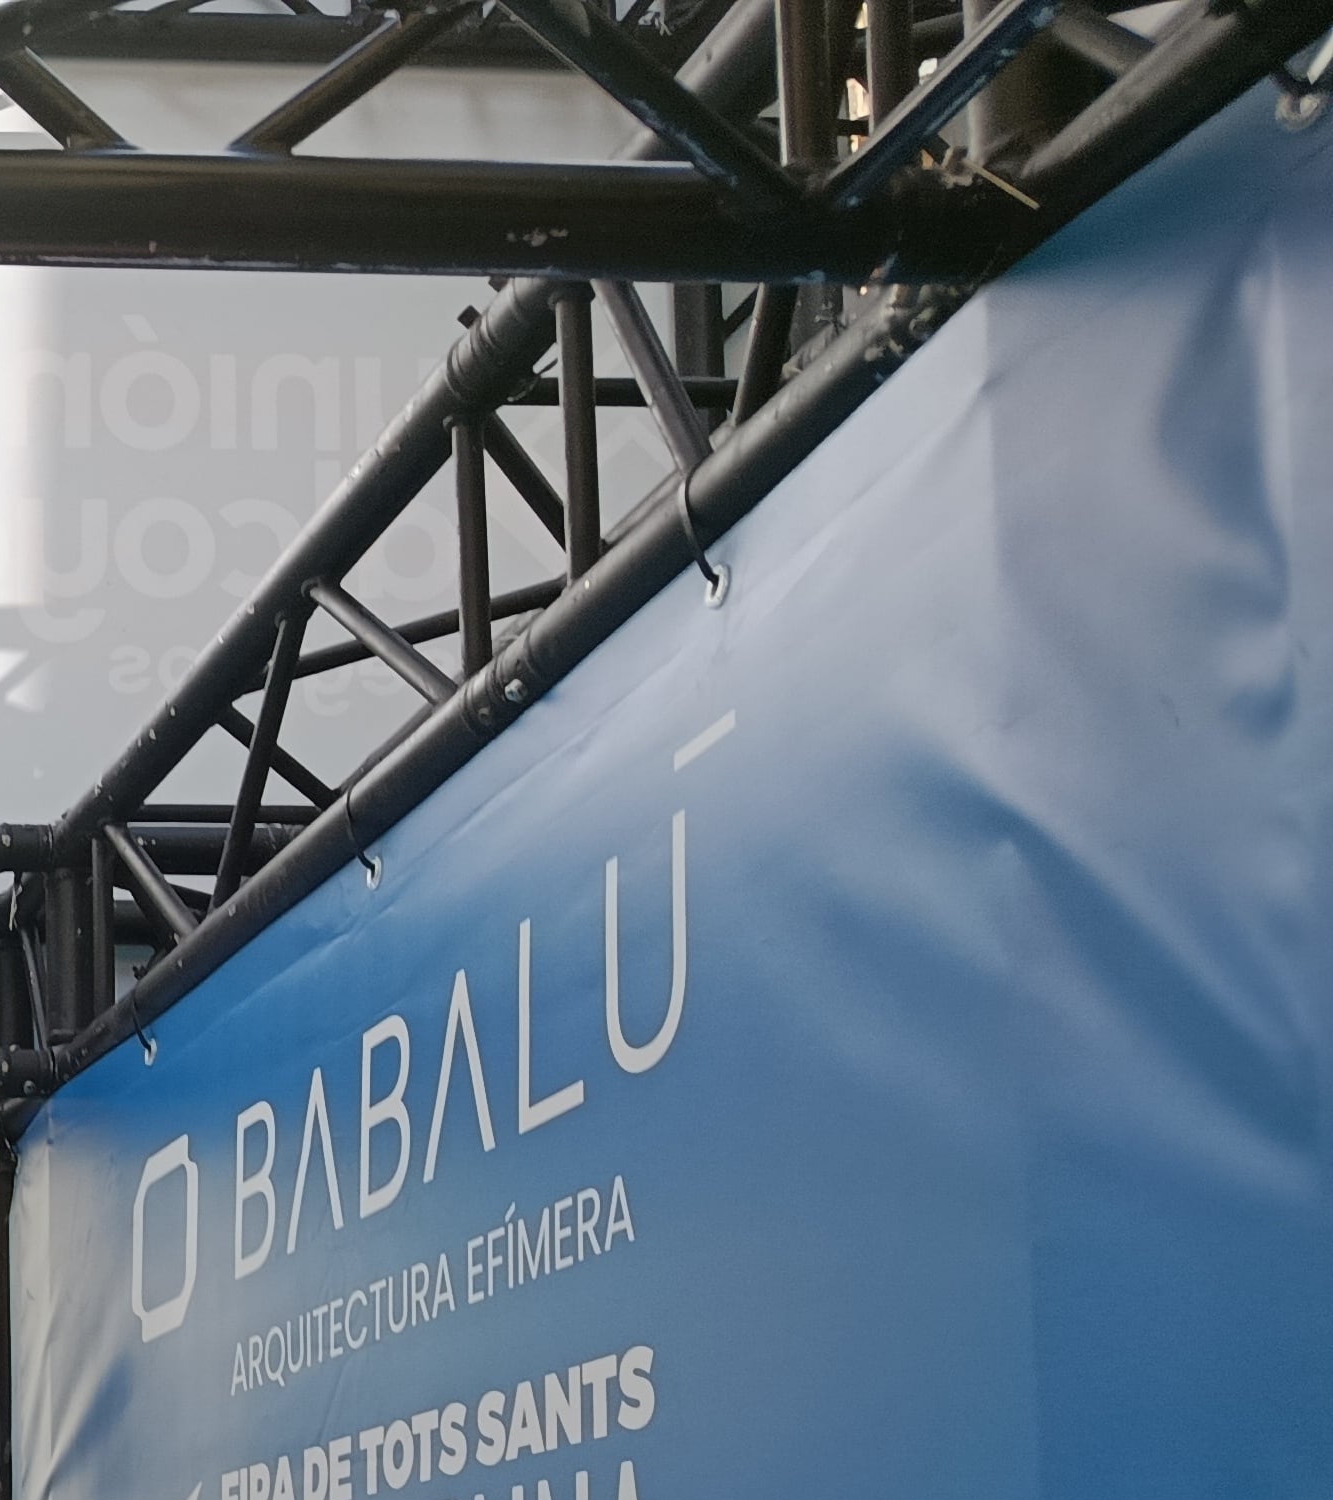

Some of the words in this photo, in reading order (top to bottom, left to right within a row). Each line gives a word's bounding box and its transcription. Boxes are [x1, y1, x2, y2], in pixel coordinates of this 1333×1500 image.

[229, 1254, 457, 1397] ARQUITECTURA
[466, 1174, 637, 1304] EFÍMERA
[359, 1403, 468, 1492] TOTS
[475, 1344, 656, 1469] SANTS
